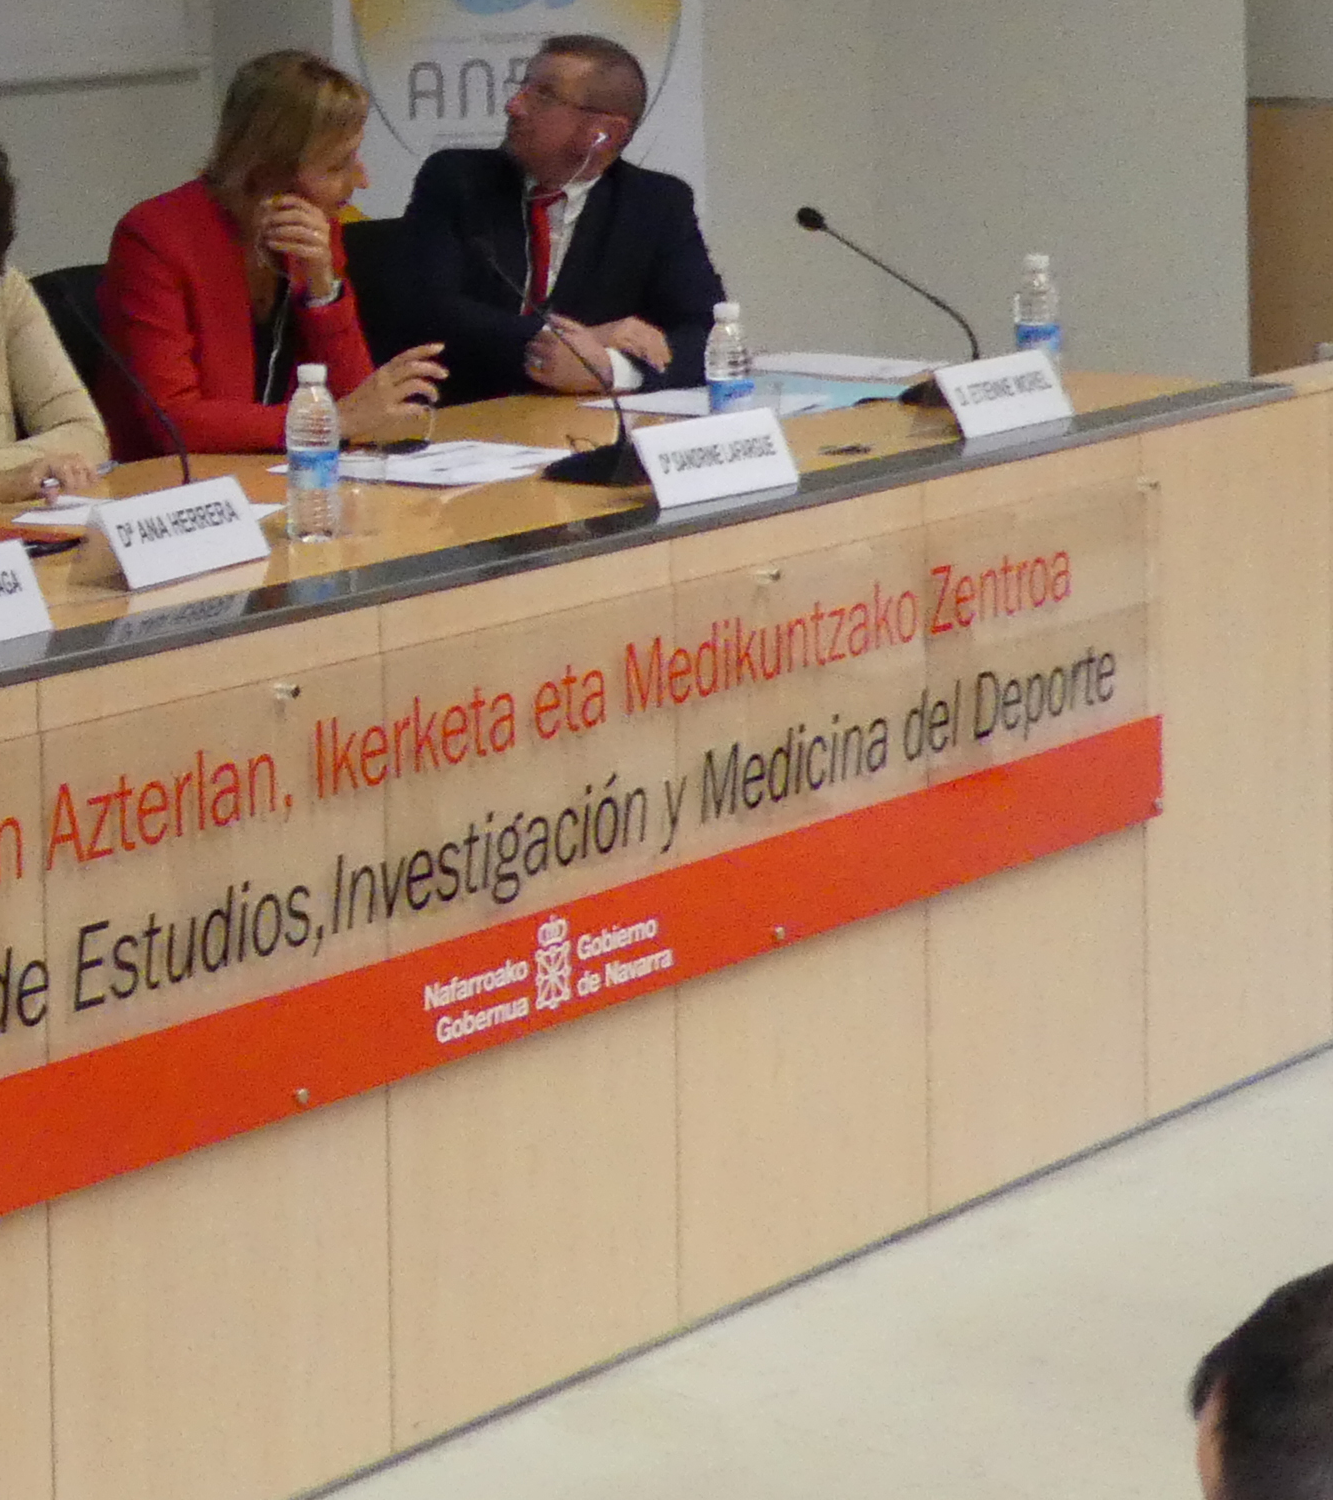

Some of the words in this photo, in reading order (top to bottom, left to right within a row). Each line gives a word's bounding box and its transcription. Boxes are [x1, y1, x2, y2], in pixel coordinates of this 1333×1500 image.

[137, 515, 171, 545] ANA
[168, 500, 240, 538] HERRERA
[45, 748, 294, 871] Azterlan,
[315, 685, 516, 800] Ikerketa
[533, 664, 607, 741] eta
[624, 579, 920, 717] Medikuntzako
[928, 549, 1073, 636] Zentroa
[659, 775, 688, 855] y
[699, 712, 889, 826] Medicina
[902, 678, 961, 764] del
[972, 644, 1118, 741] Deporte
[577, 918, 659, 961] Gobierno
[423, 957, 531, 1012] Nafarroako
[576, 970, 602, 998] de
[604, 947, 676, 988] Navarra
[435, 996, 531, 1045] Gobernua
